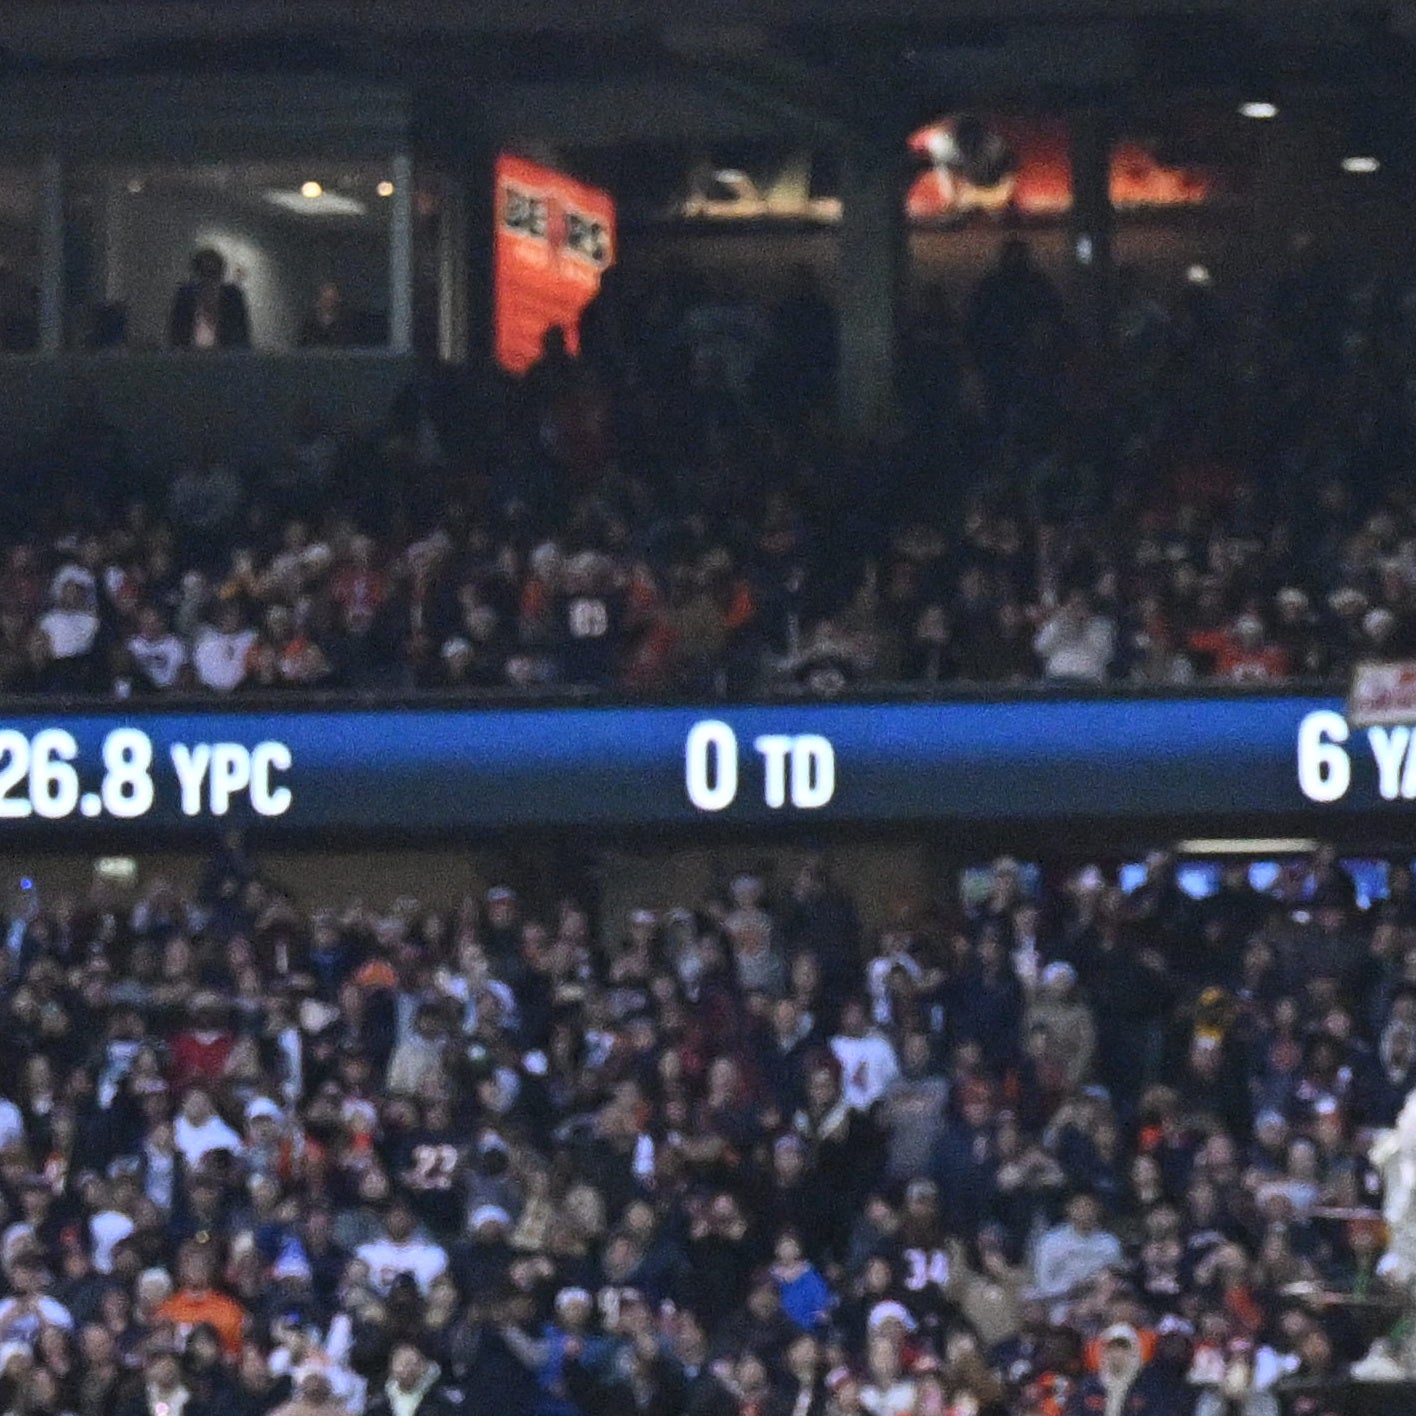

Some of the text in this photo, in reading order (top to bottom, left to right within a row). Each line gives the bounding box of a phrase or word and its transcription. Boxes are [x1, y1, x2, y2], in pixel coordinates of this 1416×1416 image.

[505, 187, 606, 262] BERS
[0, 728, 293, 818] 26.8 YPC
[686, 719, 835, 811] 0 TD
[1298, 710, 1350, 802] 6
